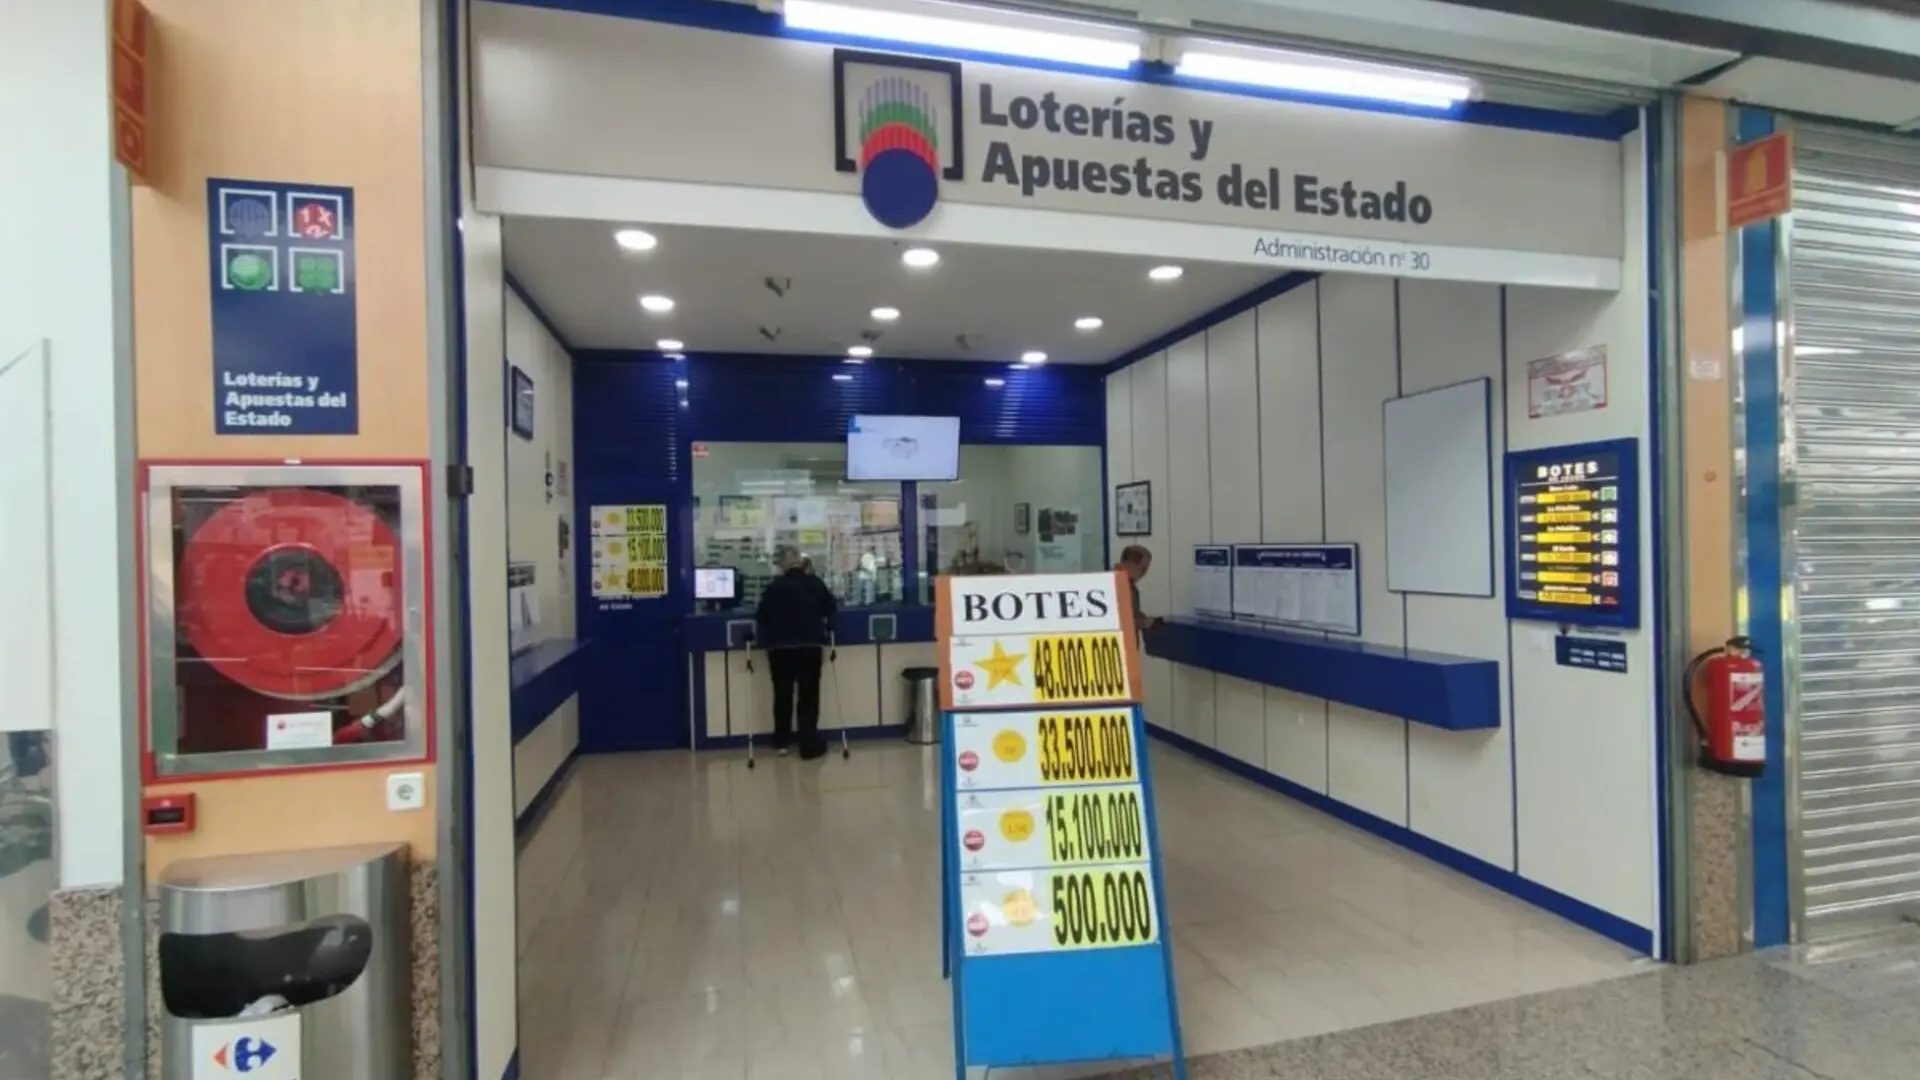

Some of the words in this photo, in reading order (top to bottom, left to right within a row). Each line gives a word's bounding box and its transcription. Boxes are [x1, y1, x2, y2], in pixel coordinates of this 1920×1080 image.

[979, 83, 1176, 146] Loterías
[1188, 116, 1214, 161] y
[981, 141, 1203, 204] Apuestas
[1216, 163, 1280, 211] del
[1293, 173, 1433, 224] Estado
[1253, 236, 1385, 267] Administración
[1410, 251, 1430, 270] 30
[223, 371, 303, 389] Loterías
[307, 375, 319, 392] y
[225, 391, 315, 410] Apuestas
[317, 391, 348, 408] del
[224, 410, 293, 427] Estado
[1536, 461, 1599, 479] BOTES
[961, 588, 1109, 622] BOTES
[1034, 636, 1125, 699] 48.000.000
[1038, 714, 1132, 781] 33.500.000
[1045, 791, 1143, 862] 15.100.000
[1052, 870, 1150, 945] 500.000
